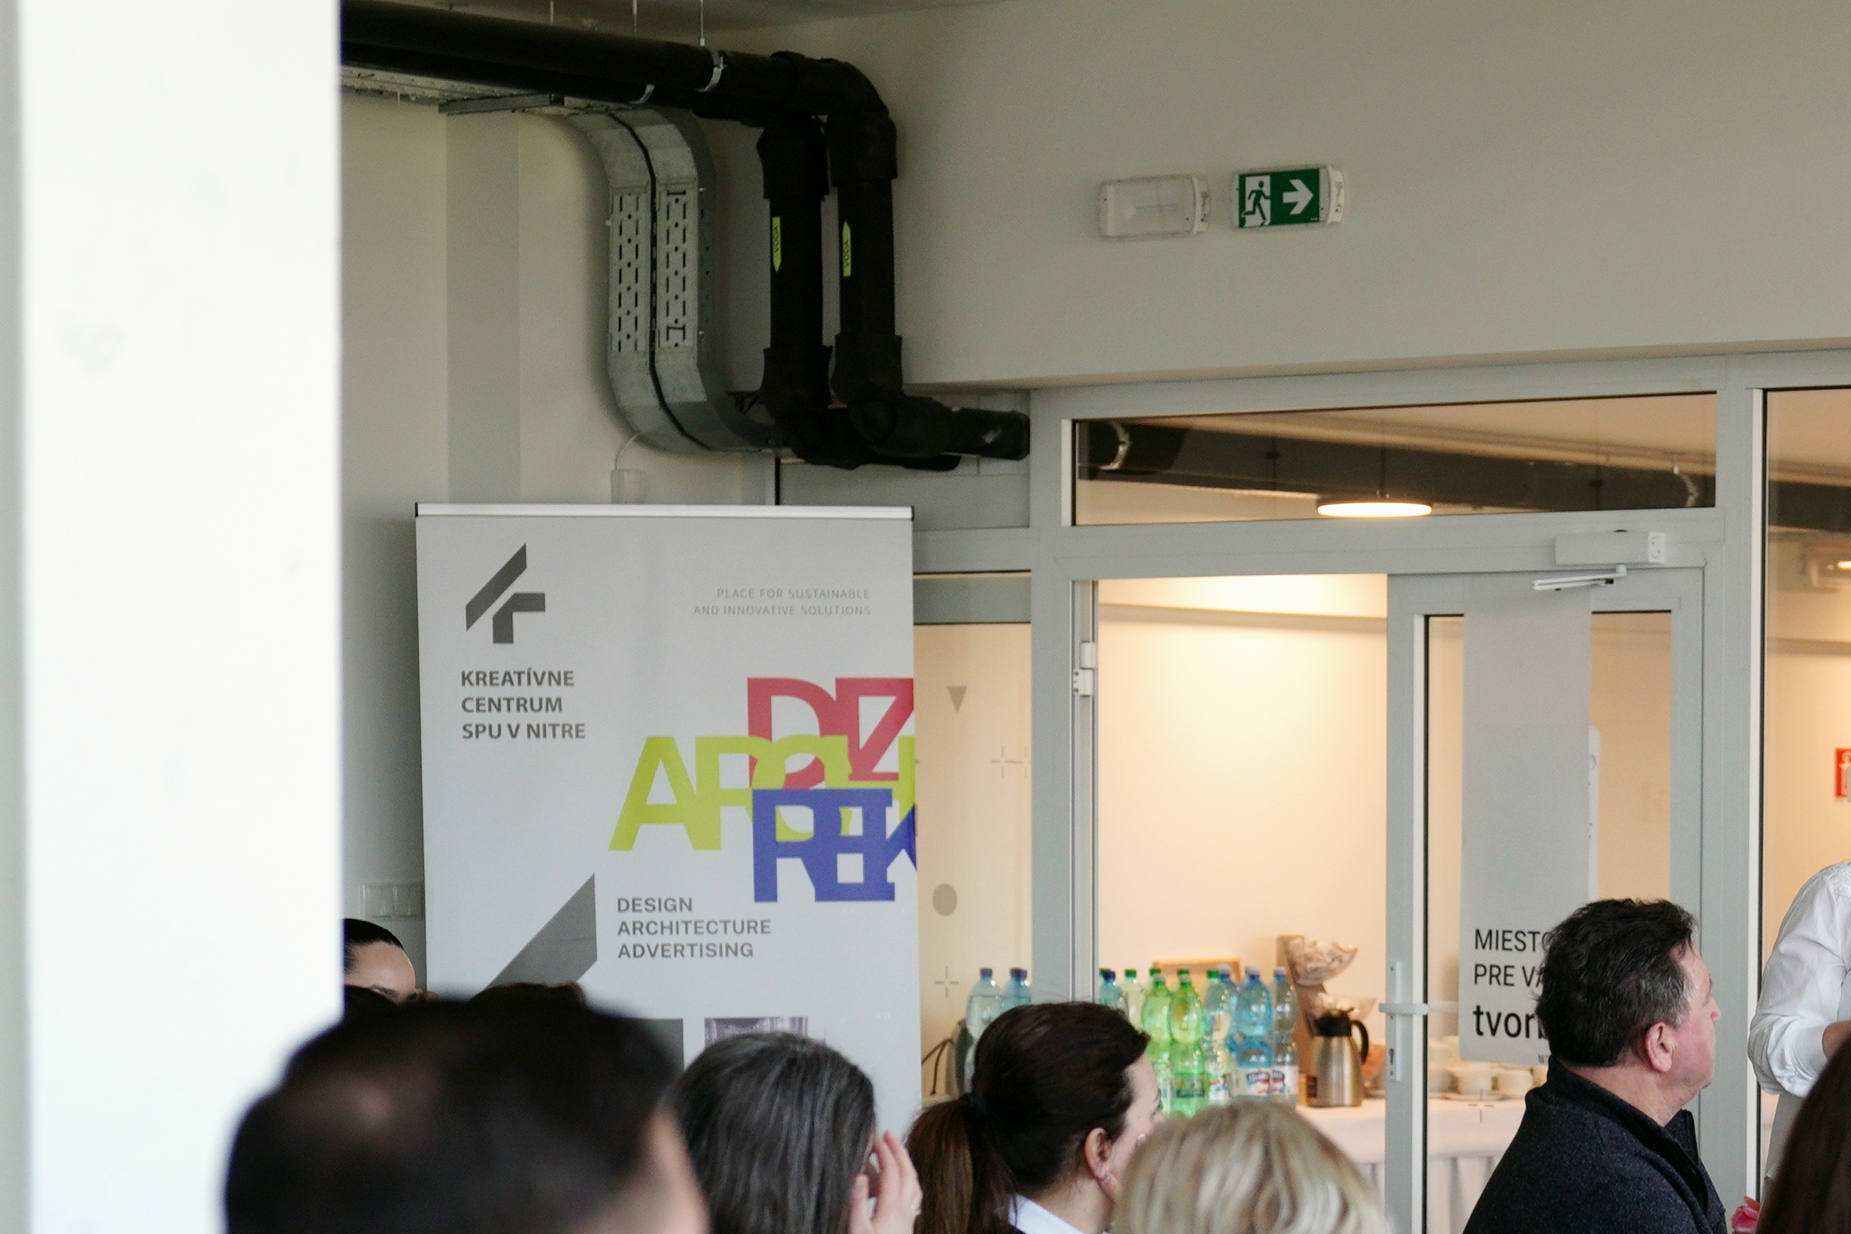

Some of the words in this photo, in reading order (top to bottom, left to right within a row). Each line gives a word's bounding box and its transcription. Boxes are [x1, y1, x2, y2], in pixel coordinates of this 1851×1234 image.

[717, 588, 754, 600] PLACE
[759, 588, 784, 600] FOR
[788, 588, 870, 600] SUSTAINABLE
[693, 605, 720, 617] AND
[723, 605, 795, 617] INNOVATIVE
[800, 605, 871, 617] SOLUTIONS
[461, 666, 575, 687] KREATÍVNE
[461, 696, 563, 714] CENTRUM
[462, 723, 502, 741] SPU
[506, 723, 521, 740] V
[526, 723, 586, 740] NITRE
[617, 897, 693, 913] DESIGN
[617, 919, 771, 936] ARCHITECTURE
[617, 942, 754, 959] ADVERTISING
[1473, 963, 1516, 987] PRE
